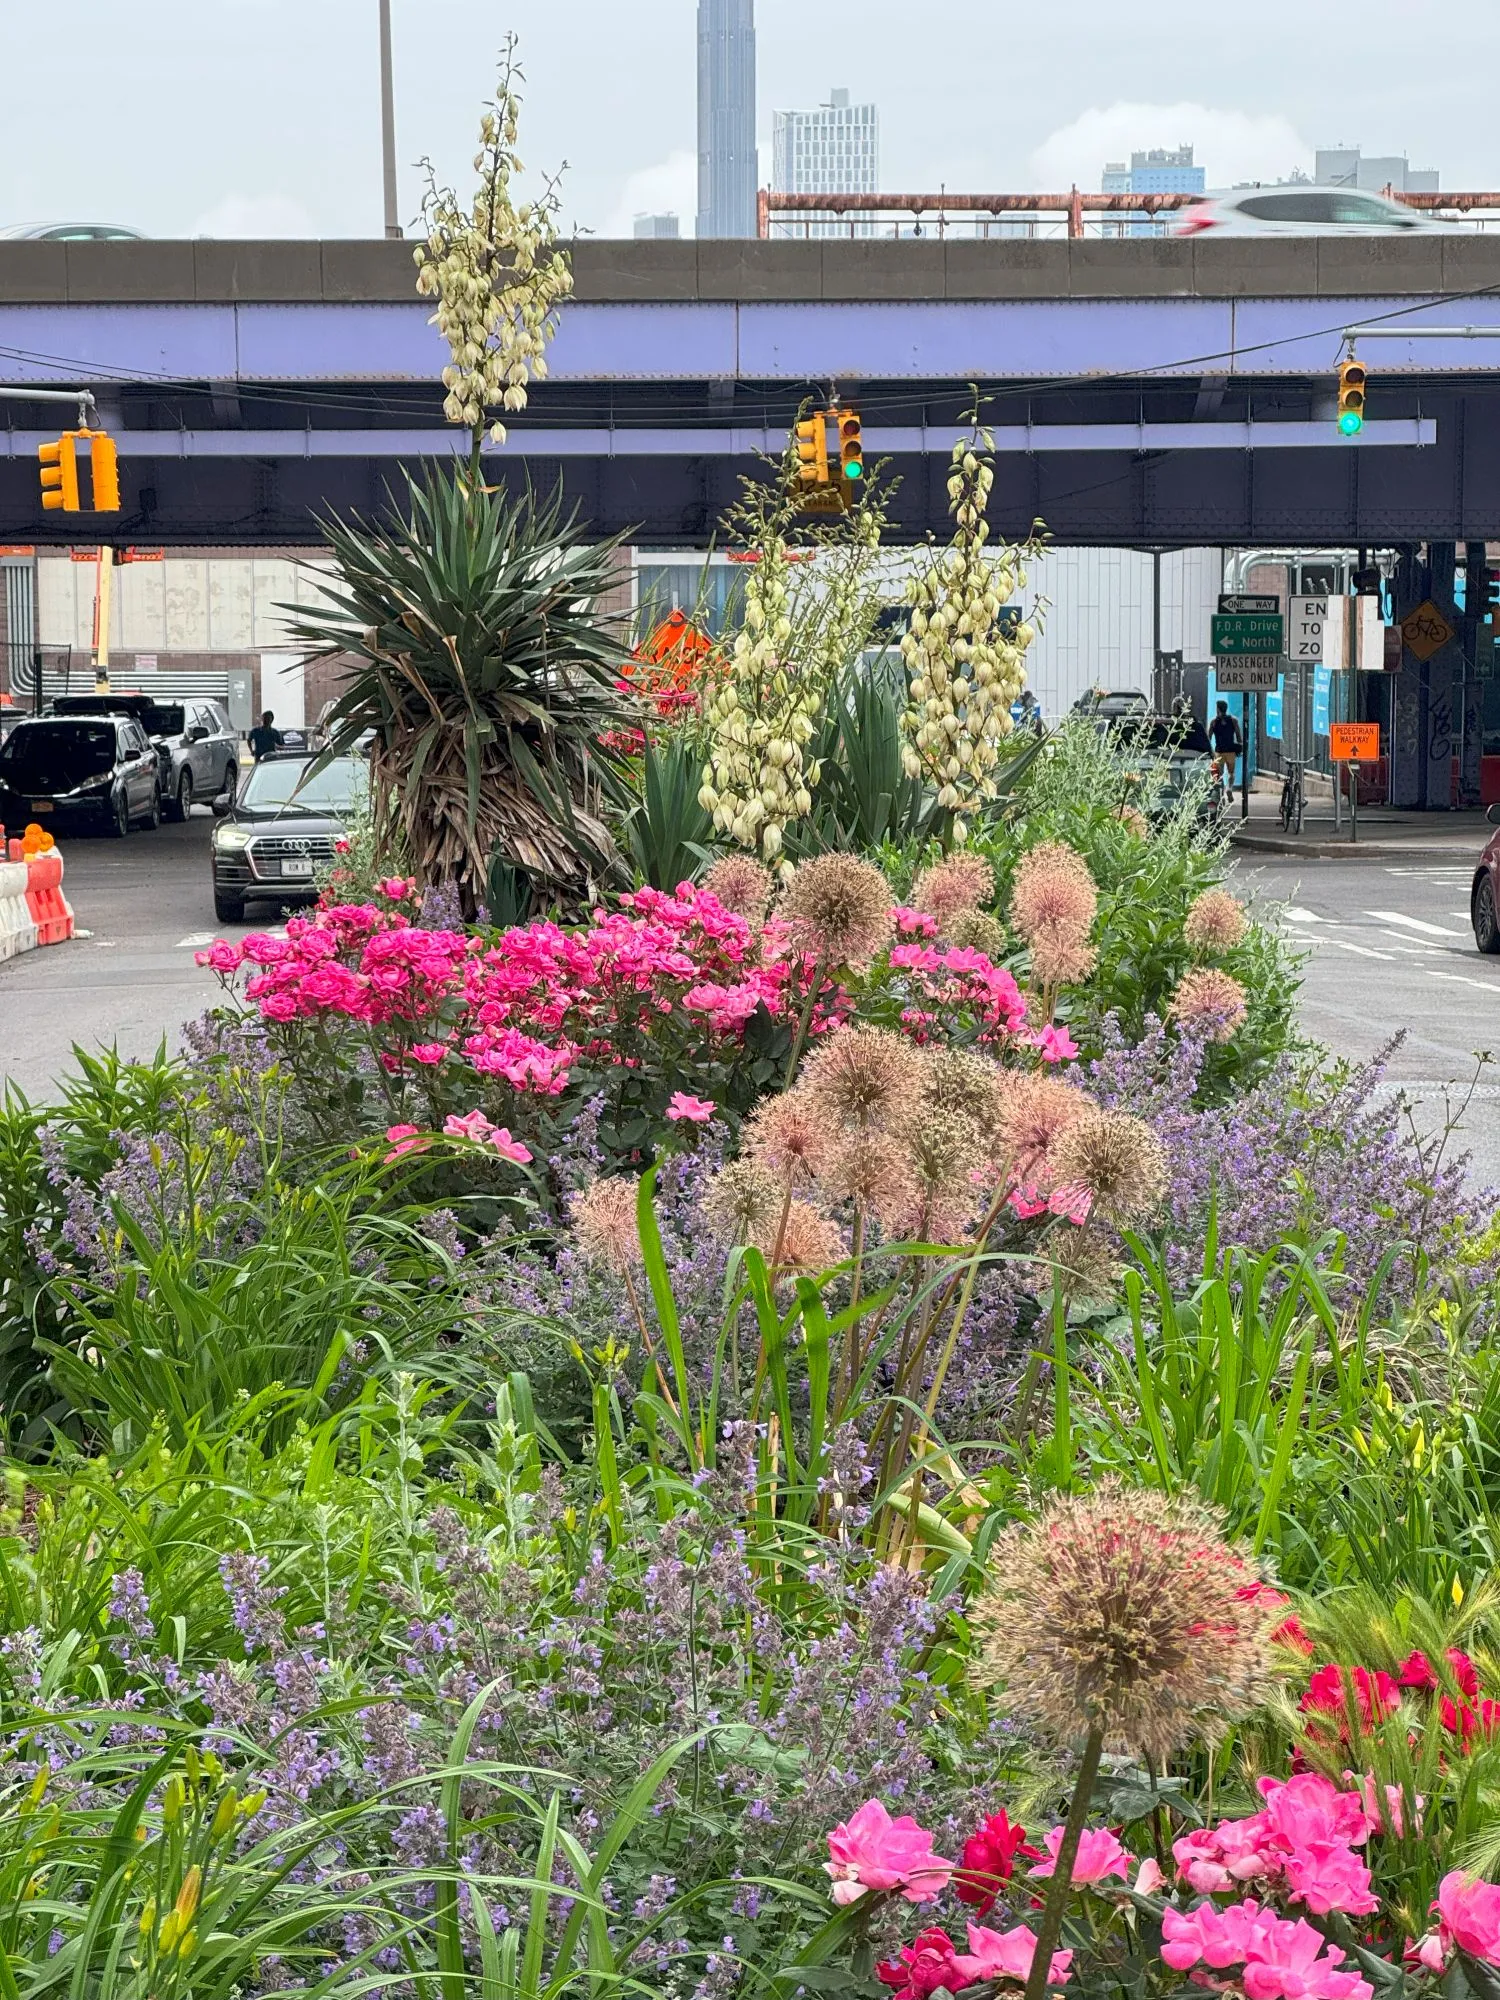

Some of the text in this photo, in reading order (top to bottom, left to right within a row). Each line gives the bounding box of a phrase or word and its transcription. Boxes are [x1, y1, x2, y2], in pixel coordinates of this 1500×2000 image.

[1227, 600, 1273, 609] ONE WAY
[1305, 602, 1326, 615] EN
[1216, 620, 1279, 632] F.D.R. Drive
[1301, 622, 1321, 635] TO
[1241, 636, 1275, 648] North
[1299, 642, 1320, 655] ZO
[1220, 656, 1274, 669] PASSENGER
[1220, 672, 1274, 684] CARS ONLY
[1335, 726, 1375, 735] PEDESTRIAN
[1340, 736, 1370, 744] WALKWAY
